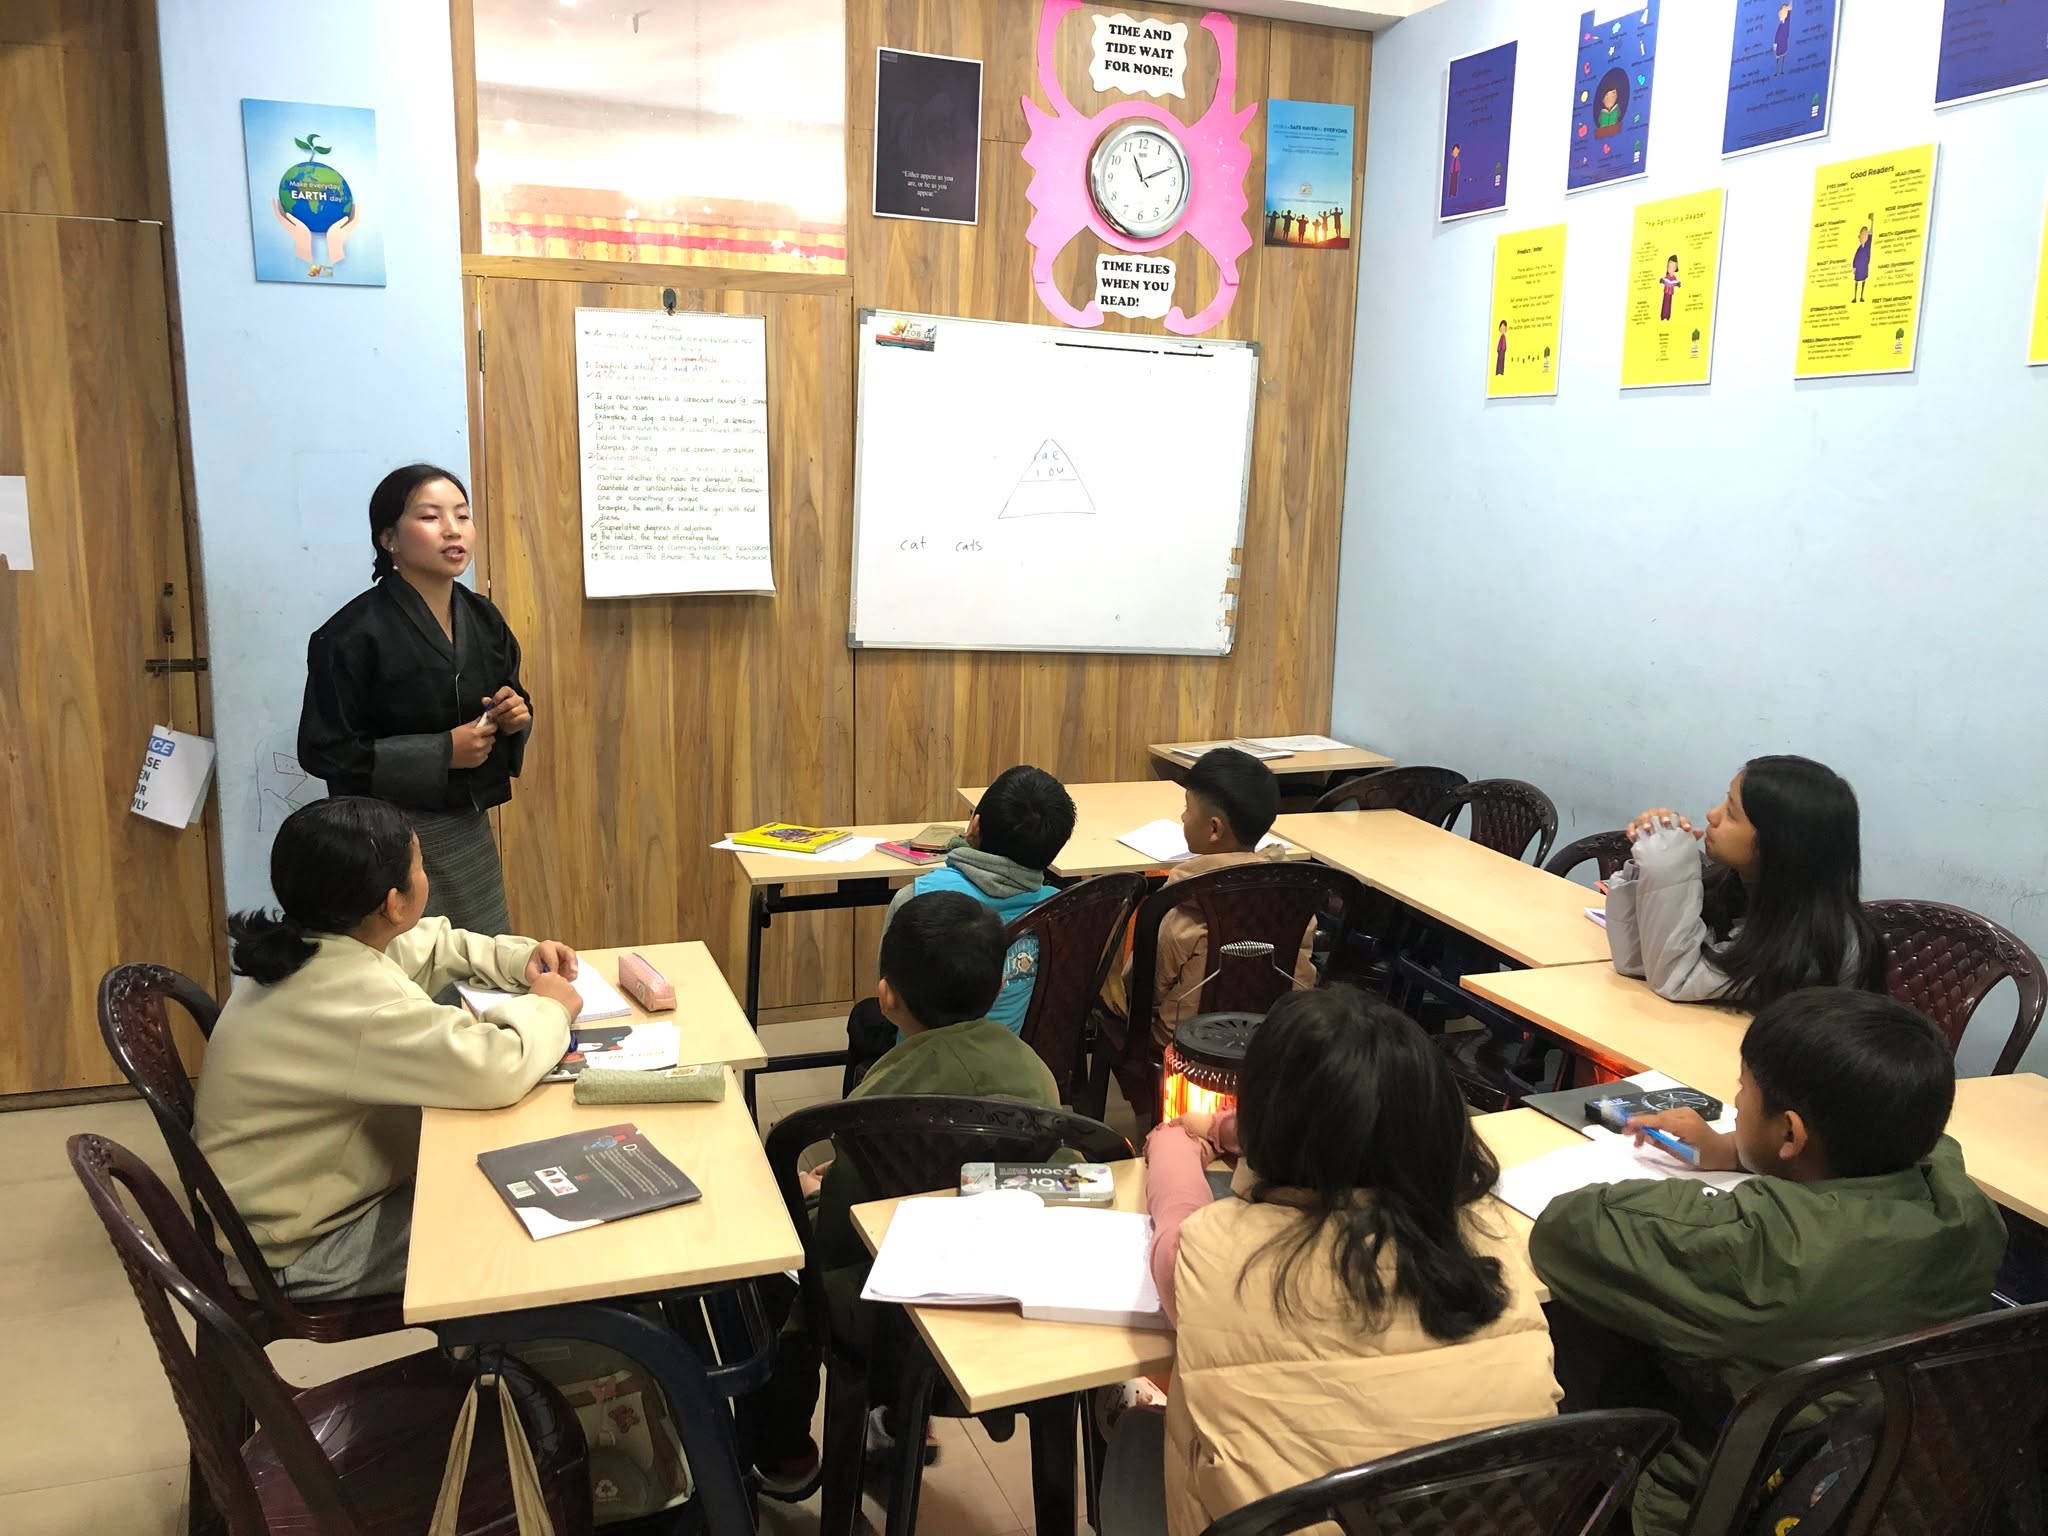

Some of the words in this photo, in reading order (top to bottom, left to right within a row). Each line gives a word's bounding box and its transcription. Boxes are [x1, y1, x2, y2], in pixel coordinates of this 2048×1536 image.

[1109, 24, 1140, 38] TIME
[1144, 29, 1172, 42] AND
[1105, 42, 1137, 56] TIDE
[1140, 46, 1174, 59] WAIT
[1104, 60, 1130, 73] FOR
[1134, 63, 1173, 77] NONE!
[1124, 142, 1133, 153] 11
[1138, 138, 1149, 150] 12
[1156, 145, 1162, 156] 1
[1111, 155, 1122, 166] 10
[1107, 172, 1114, 183] 9
[1850, 170, 1867, 180] Good
[1868, 165, 1895, 176] Readers
[288, 180, 308, 188] Make
[309, 183, 341, 191] everyday
[1170, 176, 1176, 187] 3
[291, 190, 327, 201] EARTH
[330, 196, 342, 204] day
[1111, 190, 1118, 201] 8
[1164, 194, 1171, 205] 4
[1123, 204, 1130, 215] 7
[1137, 210, 1144, 221] 6
[1152, 207, 1160, 218] 5
[1102, 260, 1132, 272] TIME
[1135, 262, 1170, 275] FLIES
[1101, 277, 1140, 290] WHEN
[1142, 280, 1170, 292] YOU
[1100, 295, 1140, 308] READ!
[900, 536, 927, 550] cat
[955, 538, 983, 552] cats
[144, 756, 161, 770] SE
